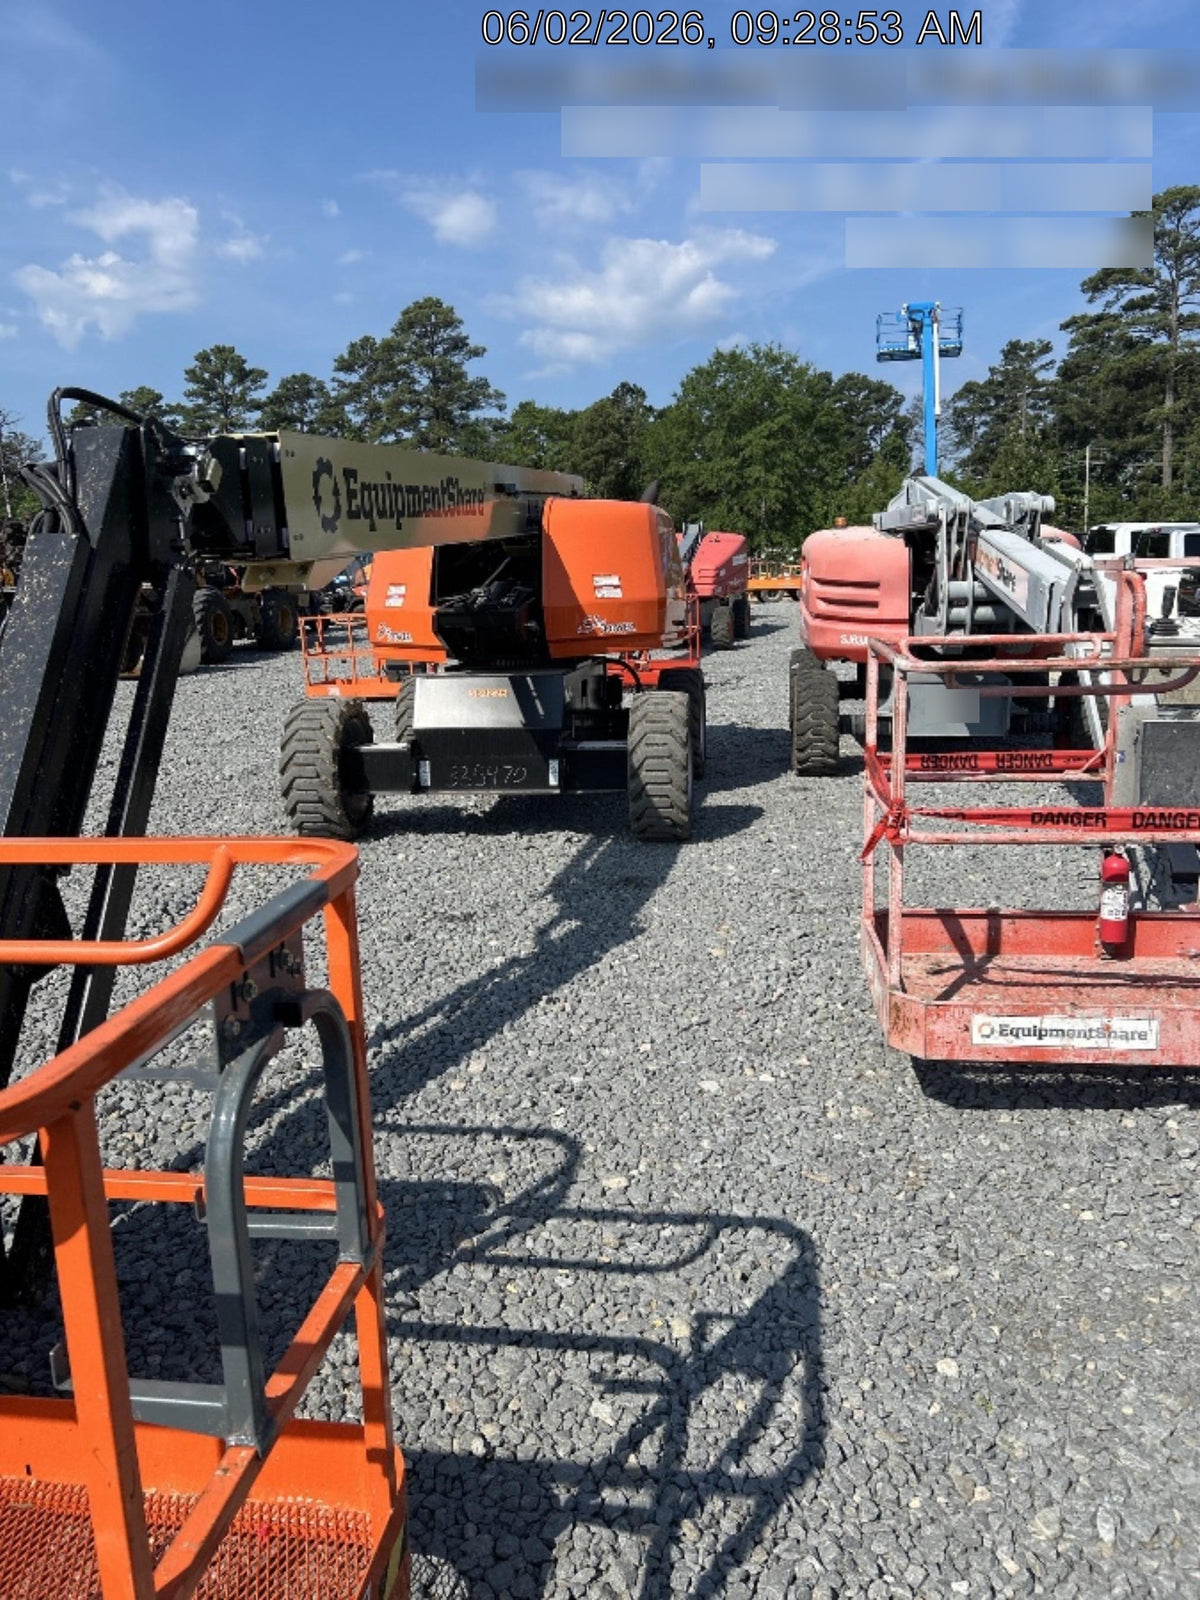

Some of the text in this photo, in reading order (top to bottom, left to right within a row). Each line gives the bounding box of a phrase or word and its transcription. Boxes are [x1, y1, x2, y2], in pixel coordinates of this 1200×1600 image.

[343, 467, 485, 532] EquipmentShare
[1030, 812, 1200, 829] DANGER DANGE
[999, 1024, 1149, 1041] EquipmentShare
